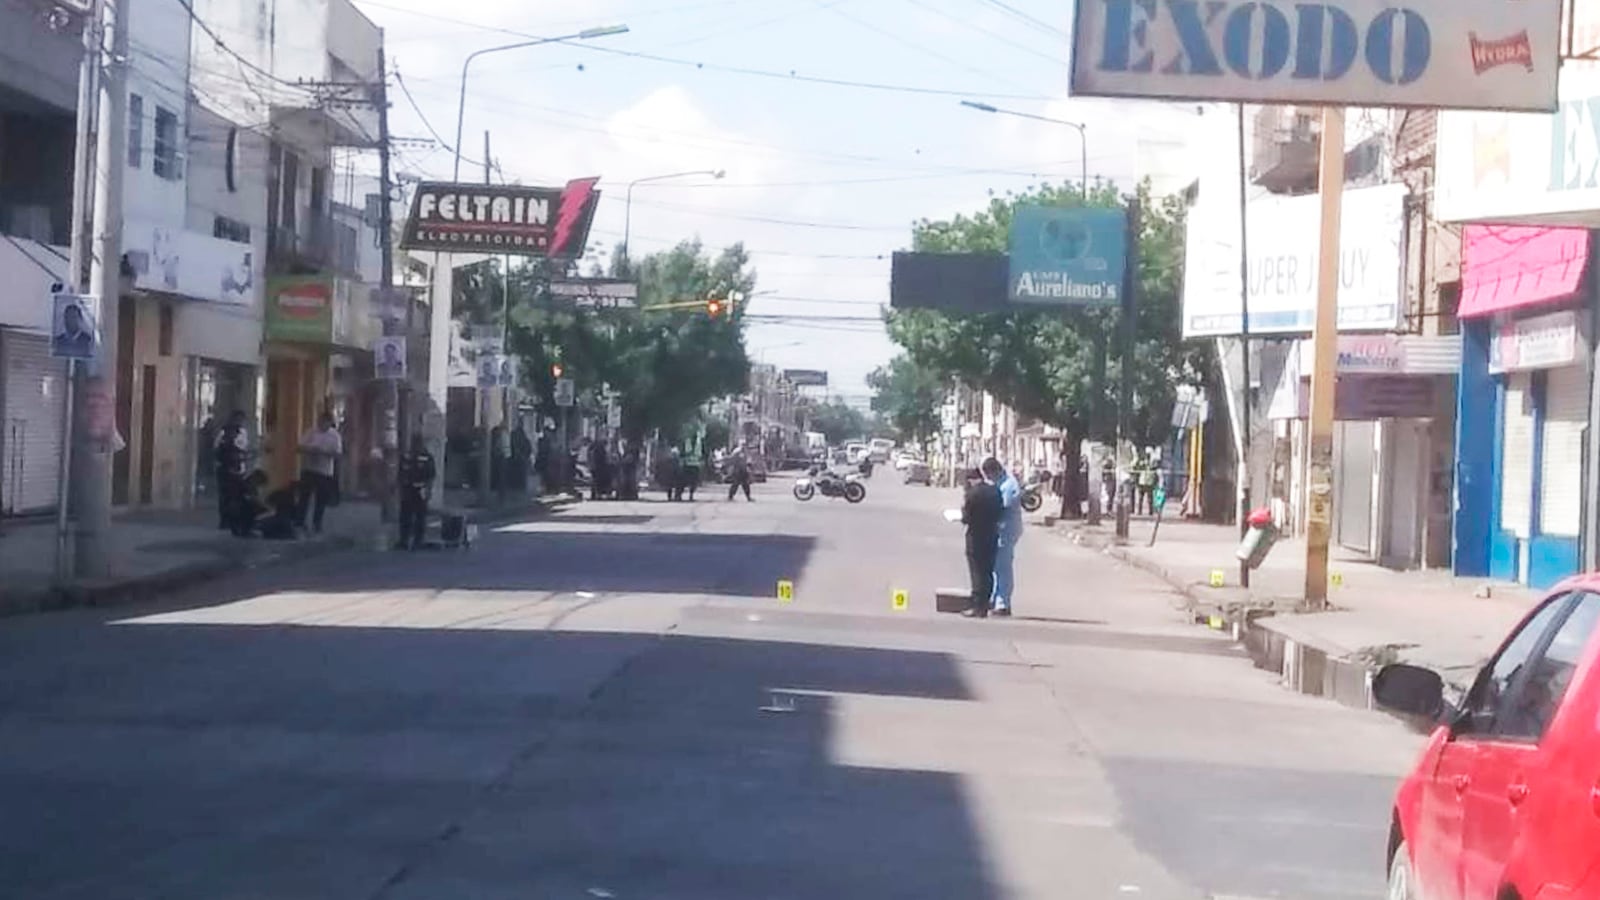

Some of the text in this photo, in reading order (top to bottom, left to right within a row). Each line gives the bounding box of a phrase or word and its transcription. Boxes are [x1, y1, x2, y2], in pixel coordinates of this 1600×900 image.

[1097, 0, 1431, 84] EXODO
[1016, 271, 1117, 299] Aureliano's
[1241, 255, 1299, 297] UPER
[780, 584, 791, 599] 10
[895, 593, 905, 606] 9
